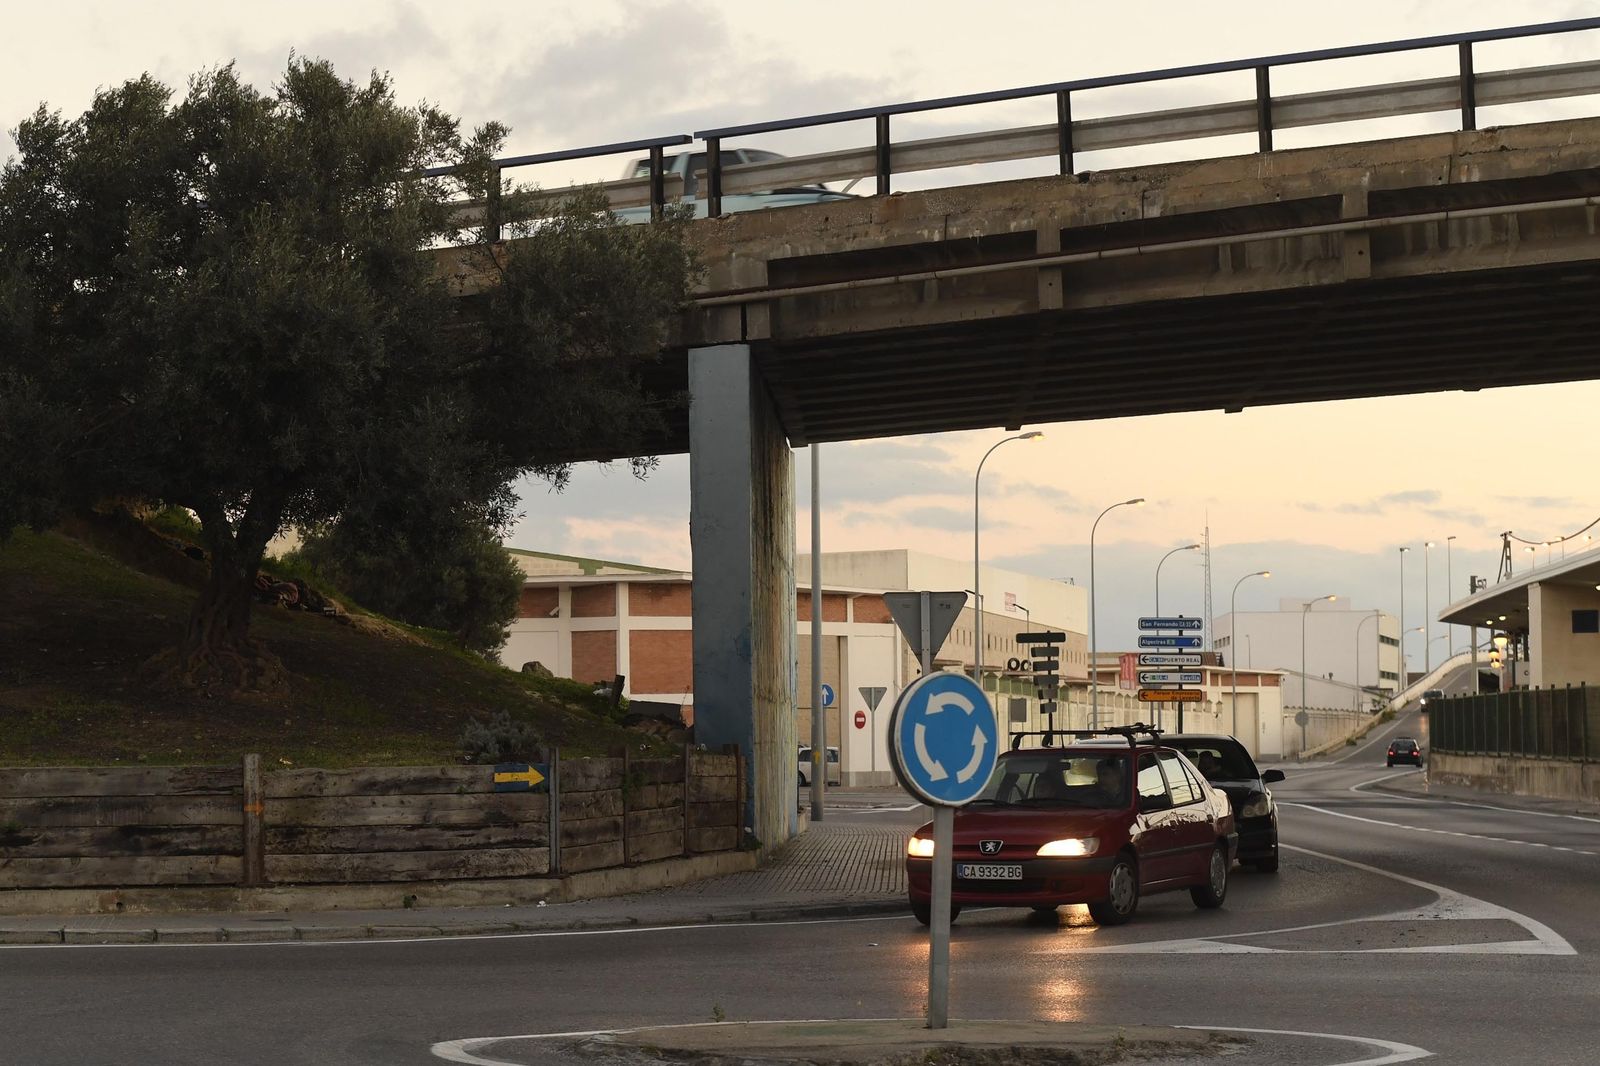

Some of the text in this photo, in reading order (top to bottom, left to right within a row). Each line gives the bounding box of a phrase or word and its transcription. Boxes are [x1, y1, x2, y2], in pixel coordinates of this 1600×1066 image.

[963, 866, 1022, 878] CA 9332 BG
